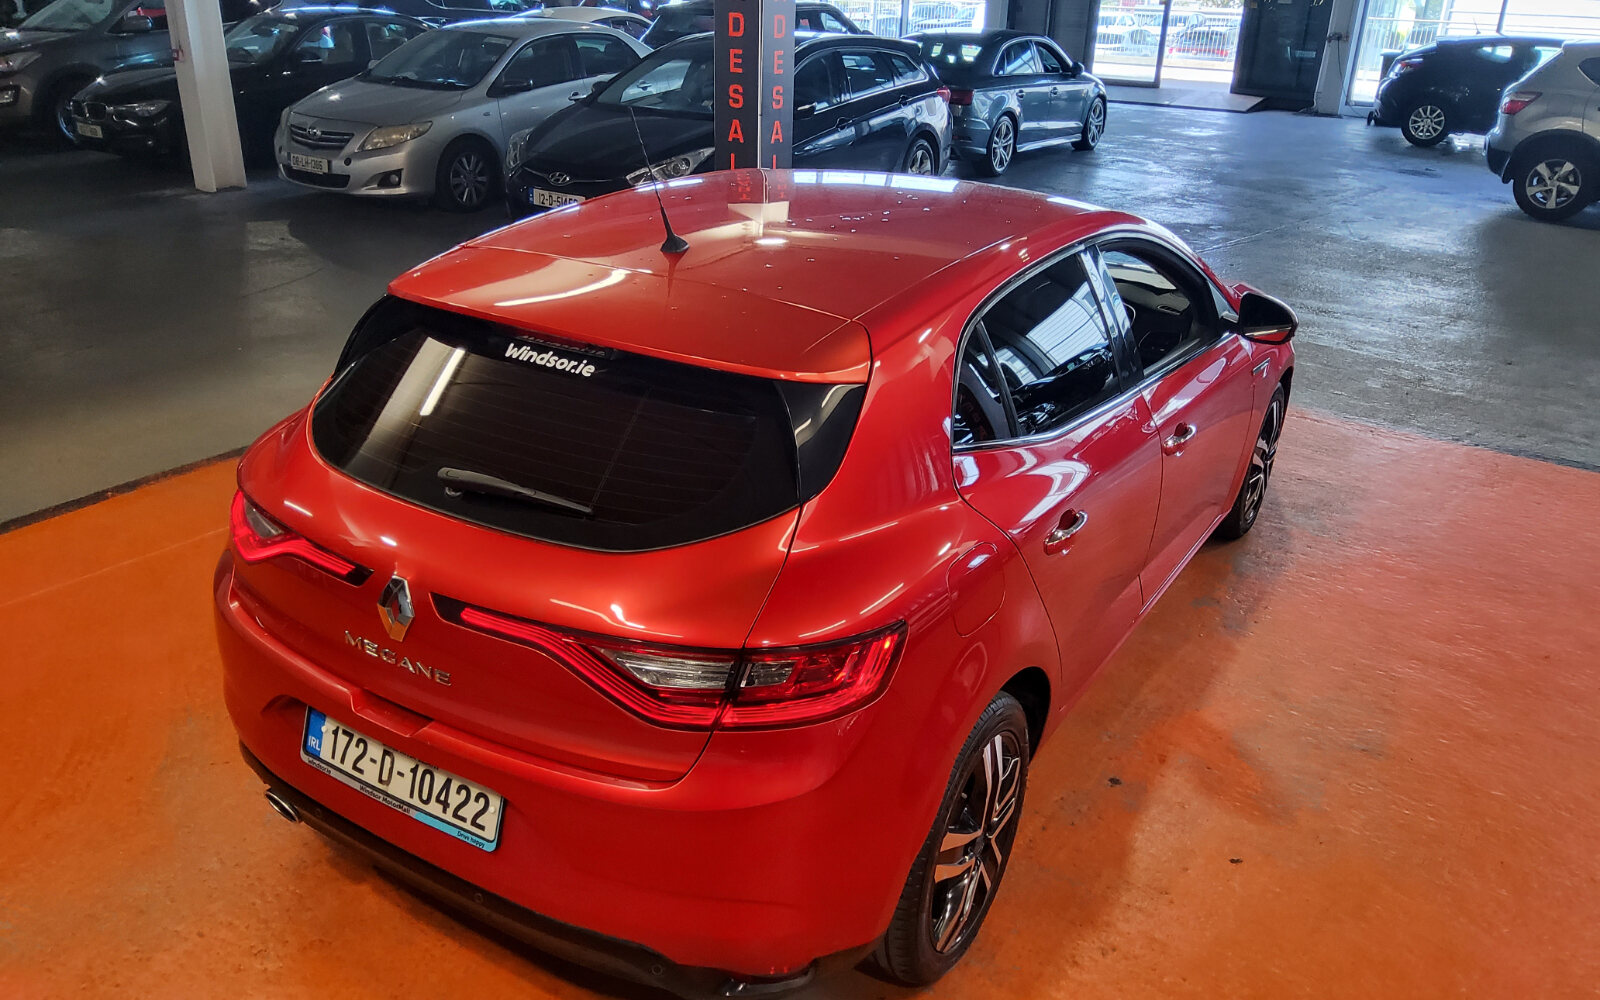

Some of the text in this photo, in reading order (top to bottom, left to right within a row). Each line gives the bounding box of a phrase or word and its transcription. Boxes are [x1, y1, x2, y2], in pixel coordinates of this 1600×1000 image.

[505, 342, 596, 377] Windsor.ie
[345, 630, 452, 686] MEGANE
[308, 735, 321, 751] IRL
[331, 725, 490, 832] 172-D-10422
[359, 784, 411, 814] Windsor MotorMall
